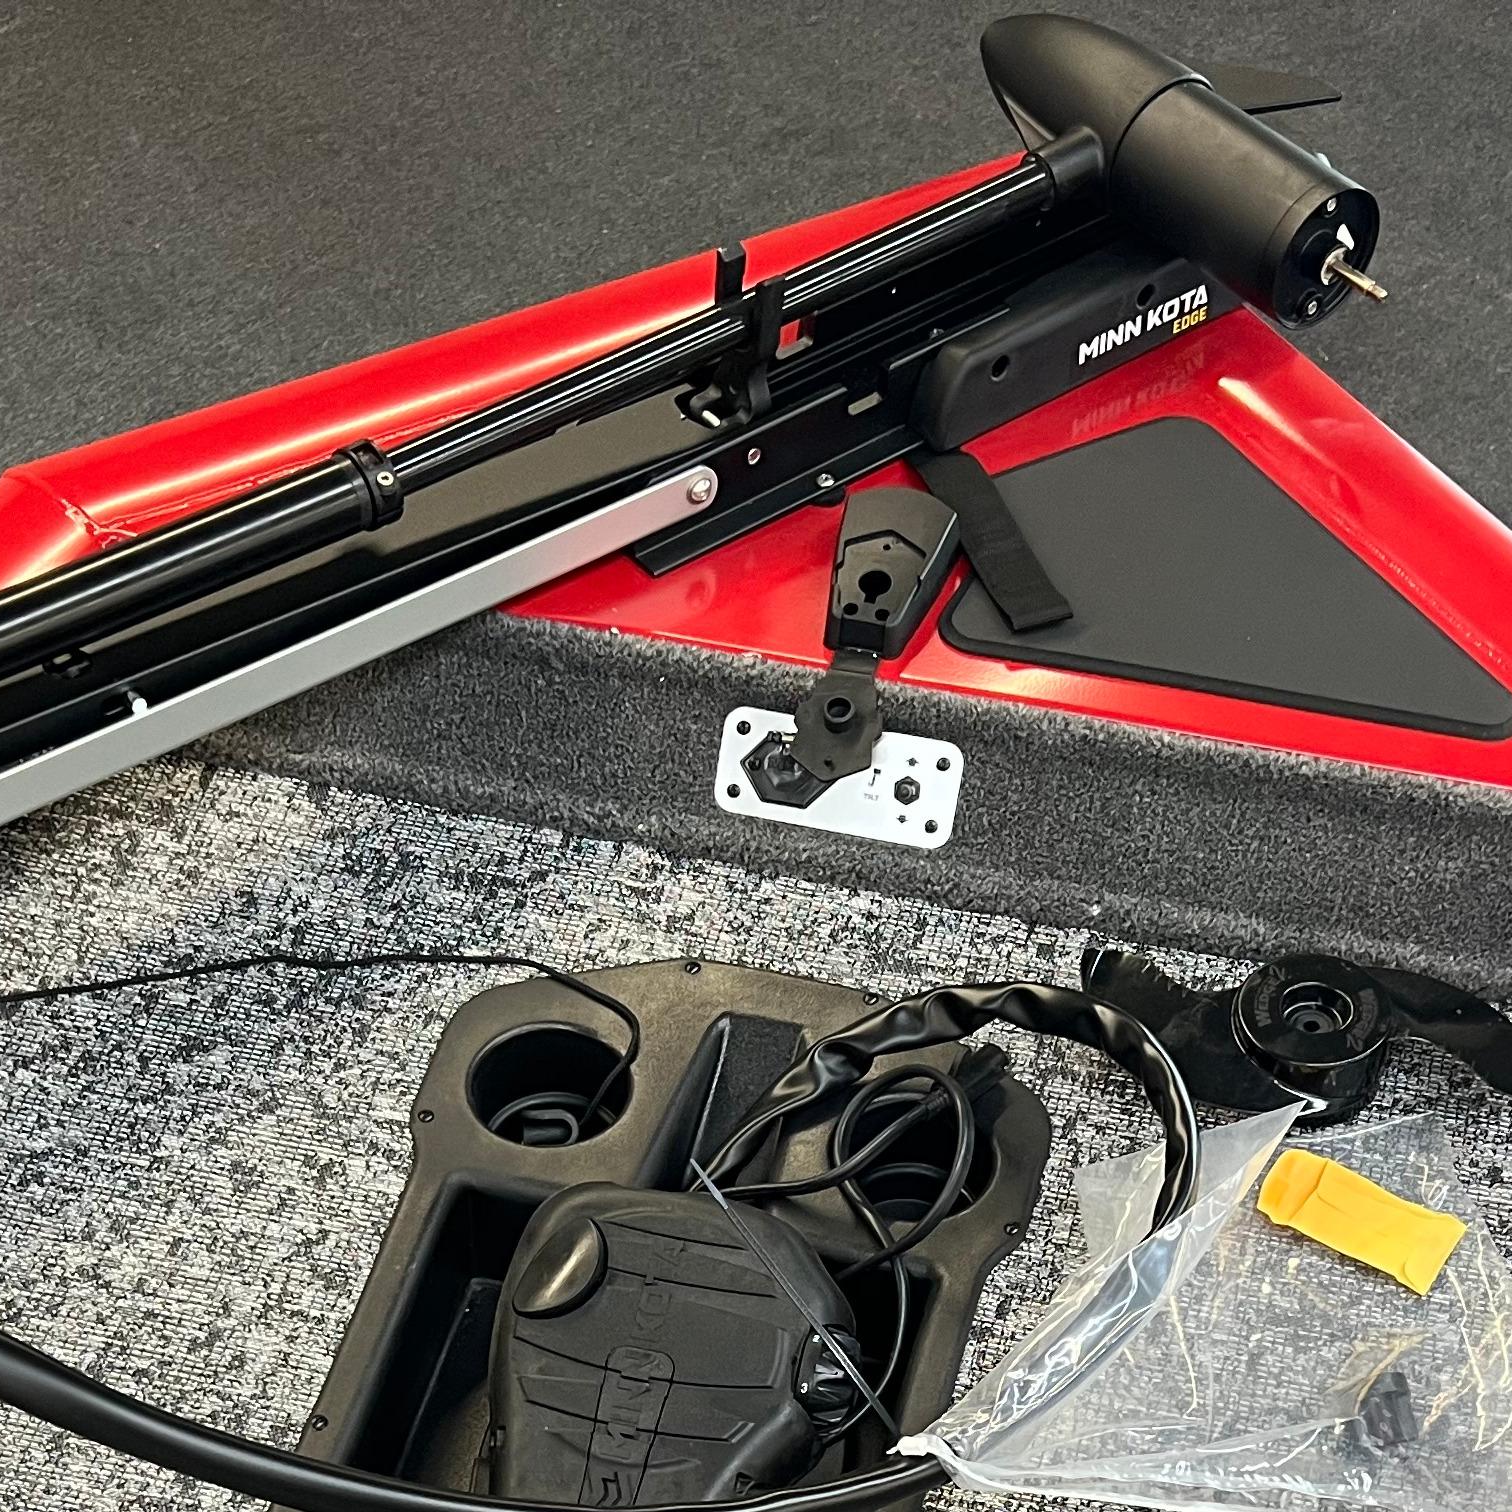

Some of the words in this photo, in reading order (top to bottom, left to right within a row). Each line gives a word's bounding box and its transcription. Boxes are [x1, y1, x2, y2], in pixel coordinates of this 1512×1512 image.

[1079, 315, 1142, 365] MINN
[1146, 284, 1208, 331] KOTA
[1173, 306, 1207, 334] EDGE
[800, 1382, 809, 1394] 3
